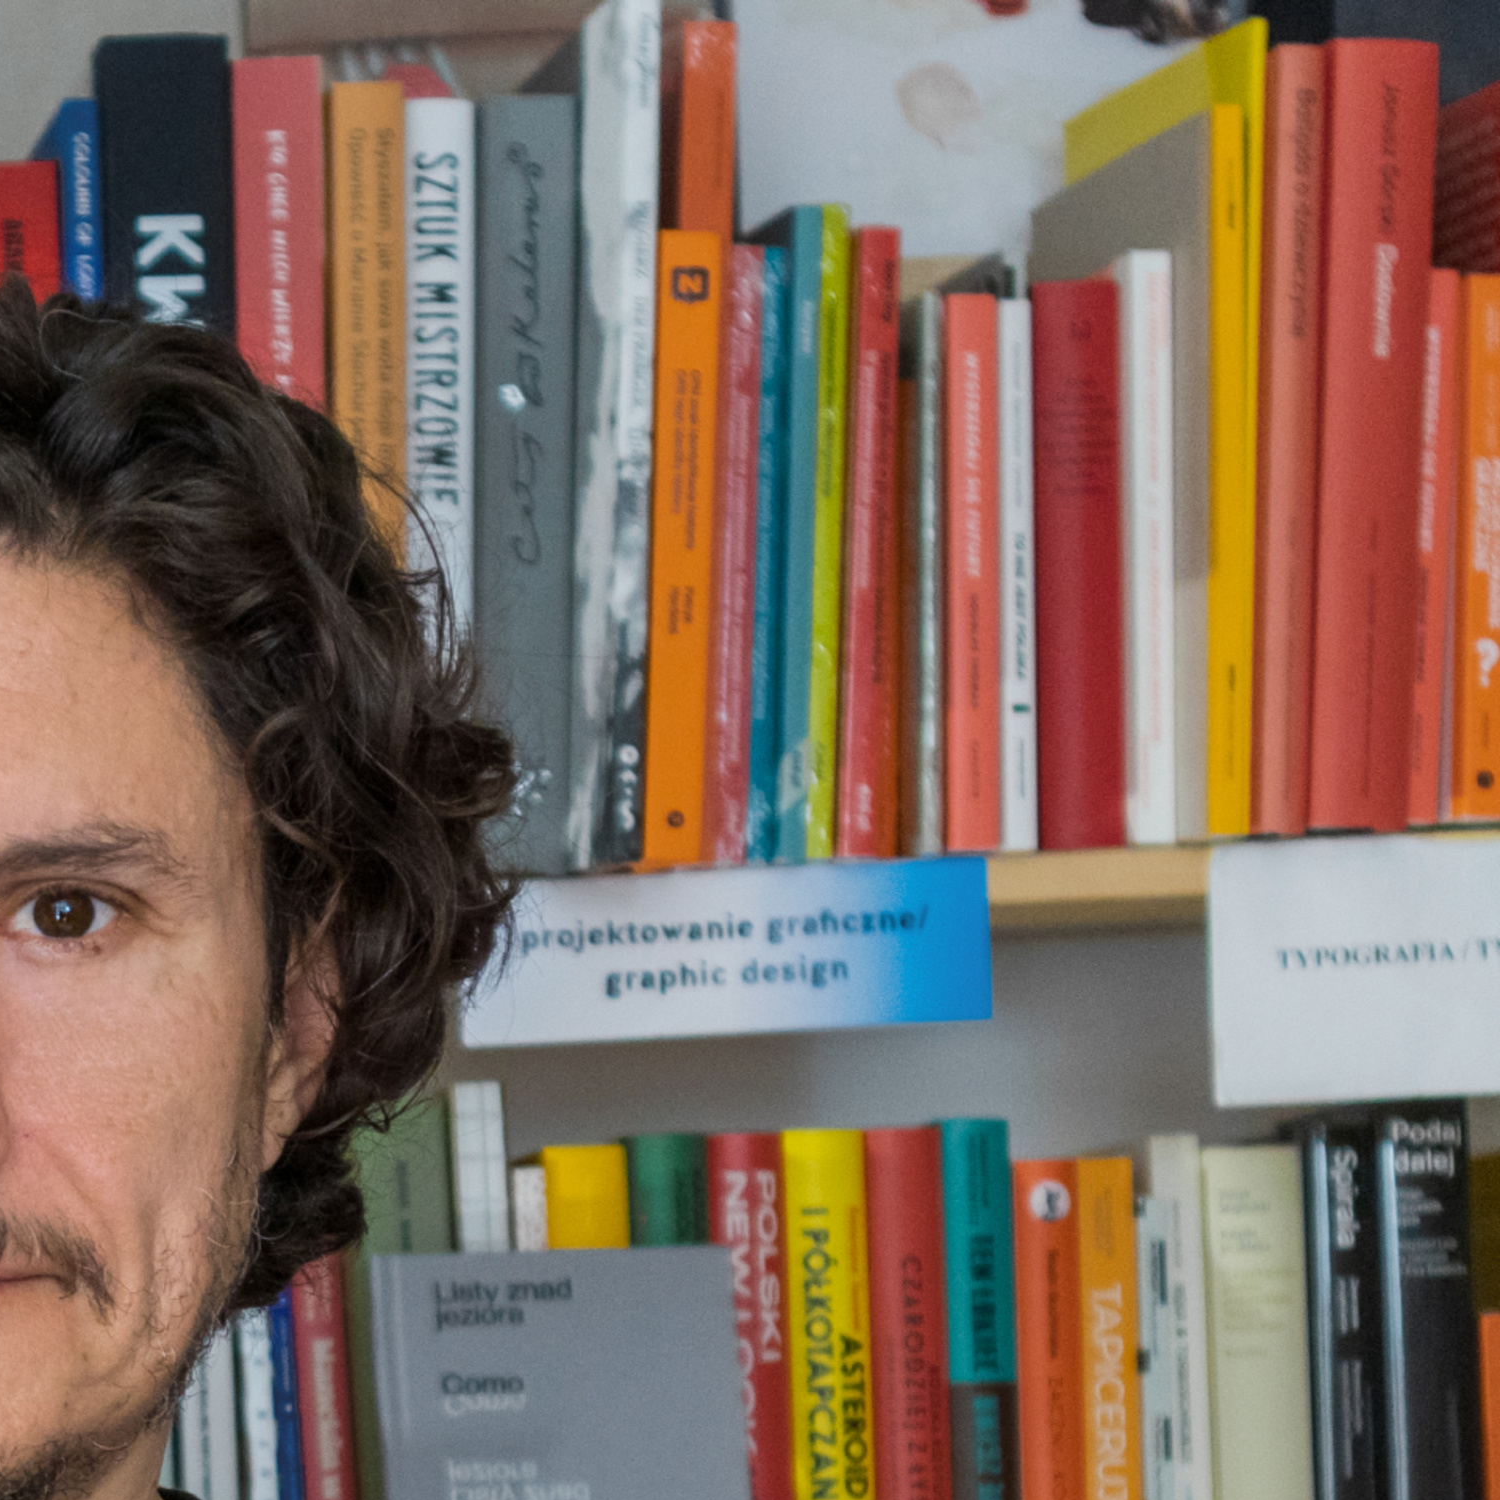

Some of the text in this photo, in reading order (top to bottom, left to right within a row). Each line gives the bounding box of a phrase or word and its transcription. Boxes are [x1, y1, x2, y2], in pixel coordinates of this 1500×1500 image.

[413, 151, 460, 507] SZTUK MISTRZOWIE
[521, 912, 755, 955] projektowanie
[1273, 942, 1456, 970] TYPOGRAFIA
[605, 953, 850, 998] graphic design
[1391, 1117, 1462, 1148] Podaj
[1393, 1145, 1456, 1178] dalej
[755, 1168, 783, 1364] POLSKI
[434, 1278, 573, 1307] Listy znad
[441, 1372, 526, 1395] Como
[839, 1331, 869, 1500] ASTEROID
